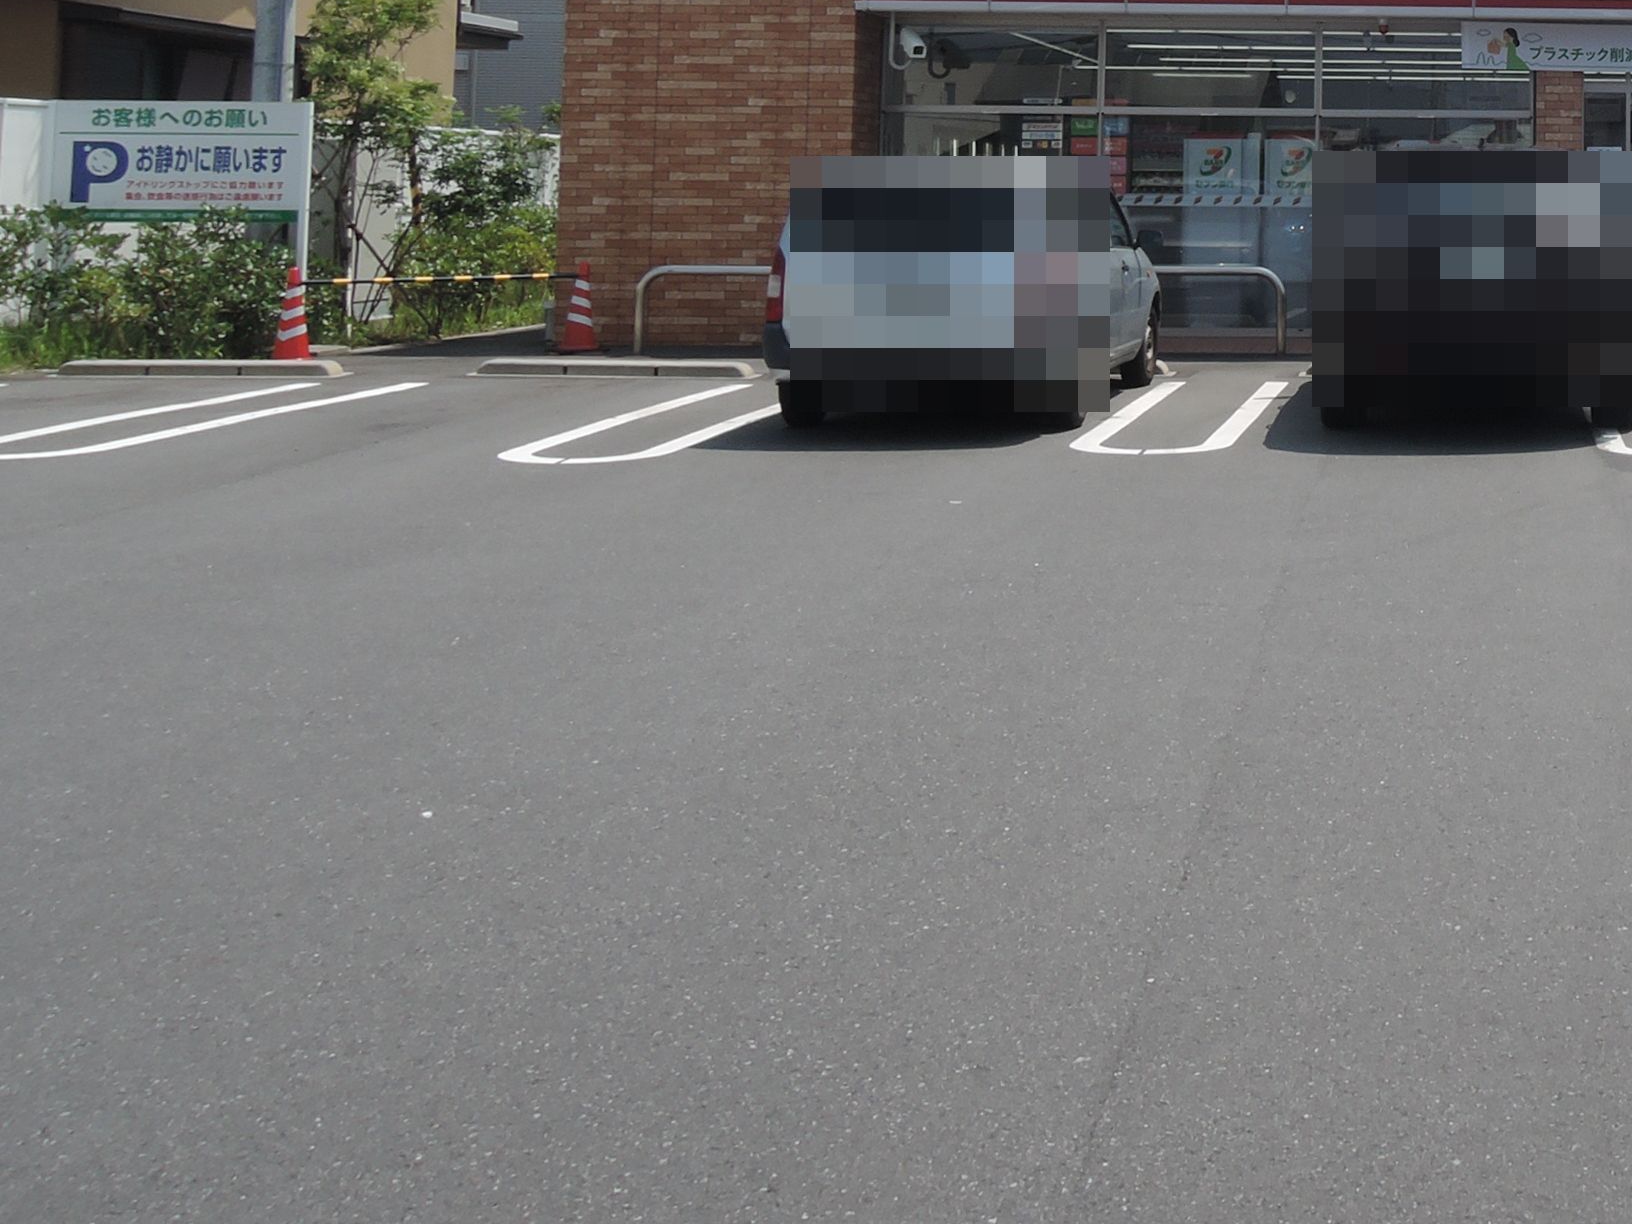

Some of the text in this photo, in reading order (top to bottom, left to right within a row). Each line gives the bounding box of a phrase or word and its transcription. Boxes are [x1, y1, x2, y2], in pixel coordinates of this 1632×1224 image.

[91, 107, 268, 128] お客様へのお願い
[135, 144, 287, 174] お静かに願います
